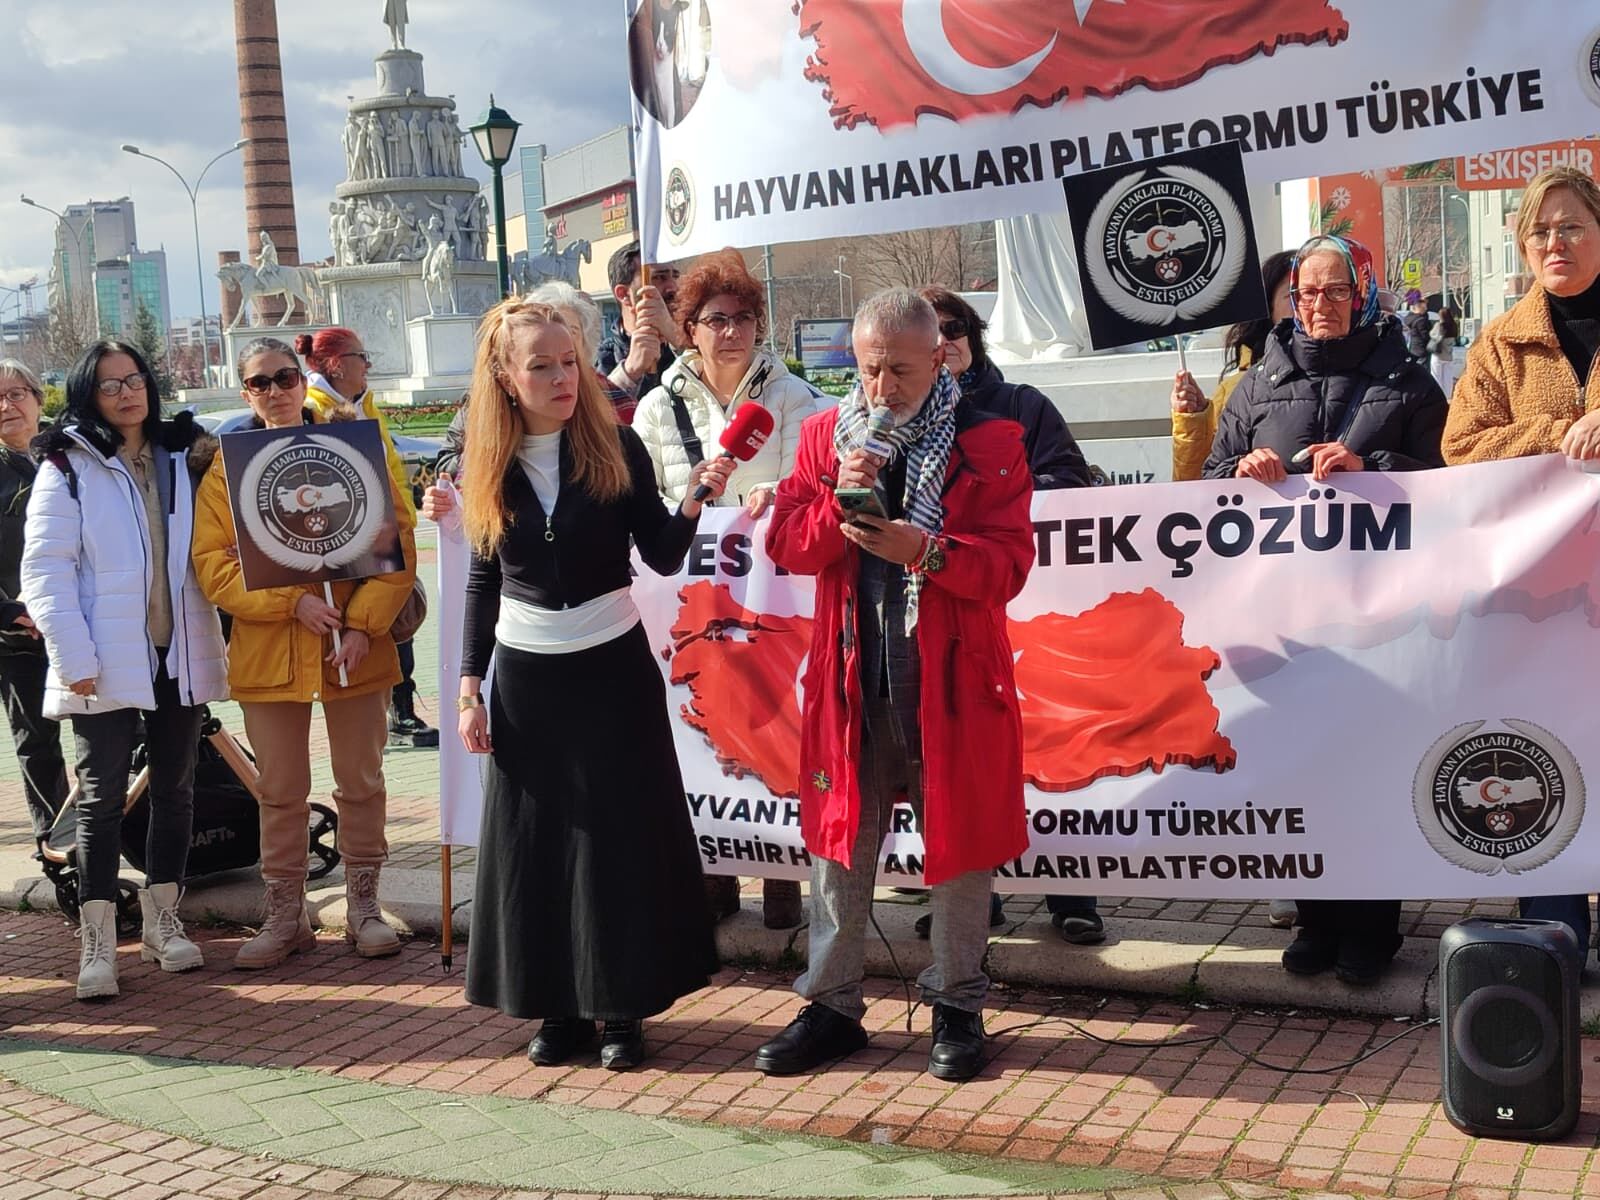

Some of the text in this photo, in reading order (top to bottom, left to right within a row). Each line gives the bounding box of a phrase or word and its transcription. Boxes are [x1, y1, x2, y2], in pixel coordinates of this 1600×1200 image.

[714, 166, 855, 221] HAYVAN
[861, 142, 1043, 203] HAKLARI
[1050, 101, 1328, 179] PLATFORMU
[1335, 66, 1544, 138] TÜRKİYE
[1105, 183, 1224, 260] HAYVAN HAKLARI PLATFORMU
[1136, 274, 1209, 305] ESKİŞEHİR
[259, 449, 366, 512] HAYVAN HAKLARI PLATFORMU
[1111, 470, 1155, 486] İMİZ
[286, 529, 353, 554] ESKİŞEHİR
[672, 533, 753, 577] ES
[1033, 514, 1143, 567] TEK
[1156, 488, 1412, 578] ÇÖZÜM
[1434, 735, 1563, 803] HAYVAN HAKLARI PLATFORMU
[687, 793, 777, 825] YVAN
[1145, 801, 1305, 836] TÜRKİYE
[699, 834, 786, 865] ŞEHİR
[1097, 853, 1325, 879] PLATFORMU
[1461, 831, 1542, 857] ESKİŞEHİR
